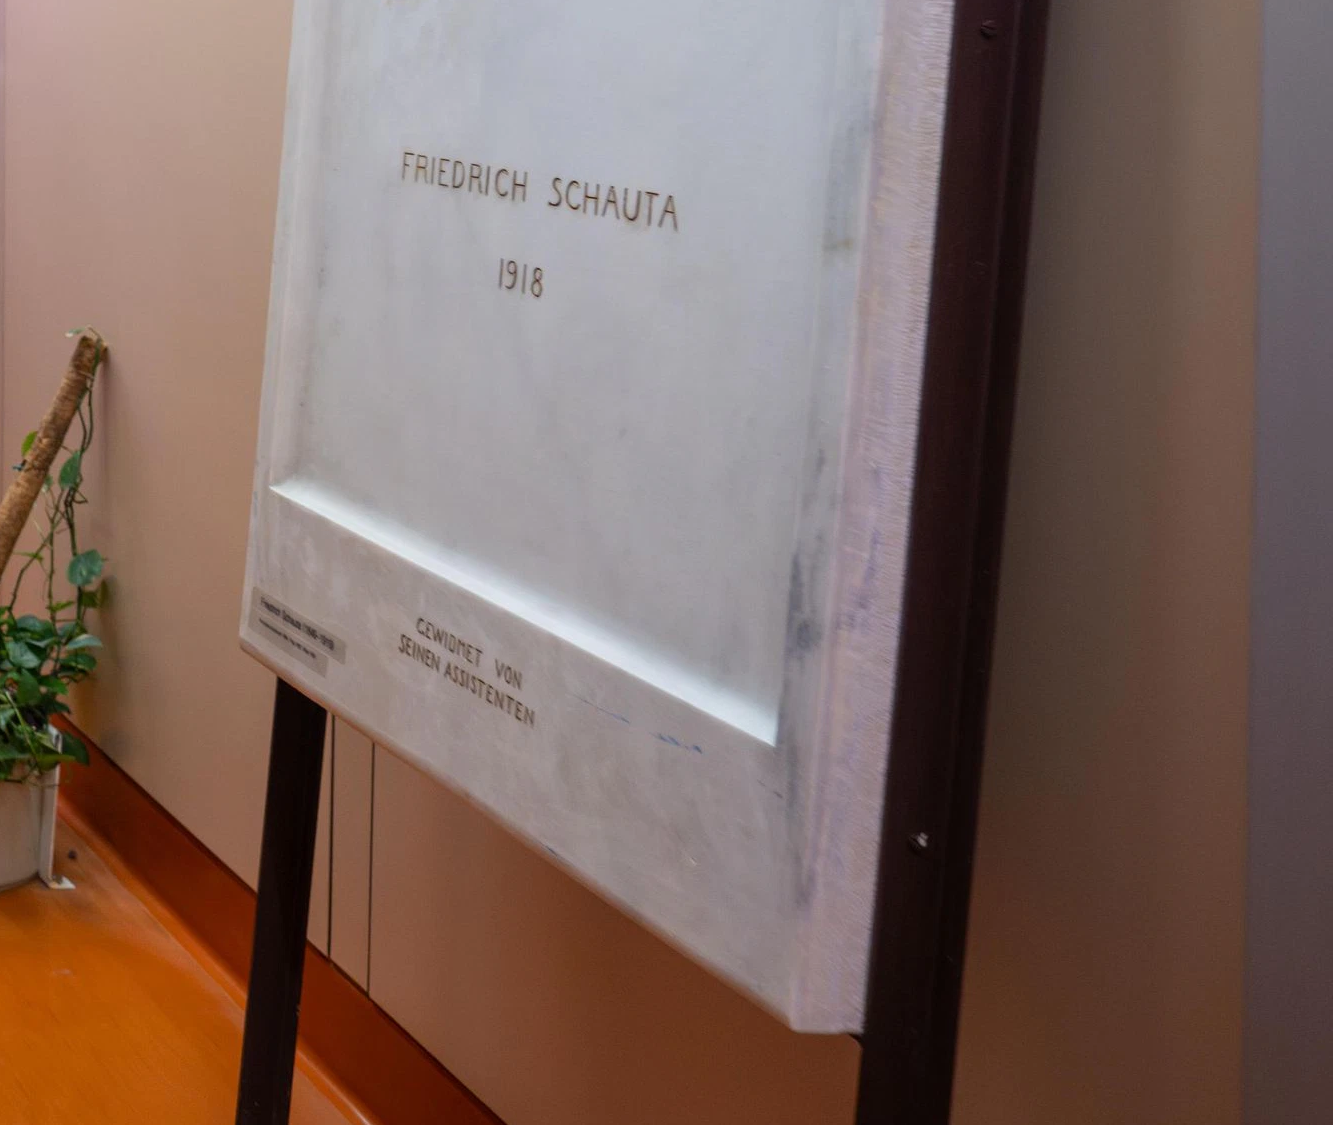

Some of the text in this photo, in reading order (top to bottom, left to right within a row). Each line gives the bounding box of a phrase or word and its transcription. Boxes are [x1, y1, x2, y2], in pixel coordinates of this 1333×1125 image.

[401, 151, 679, 232] FRIEDRICH SCHAUTA
[498, 257, 543, 298] 1918
[398, 633, 536, 728] SEINEN ASSISTENTEN
[415, 617, 523, 690] GEWIDMET VON
